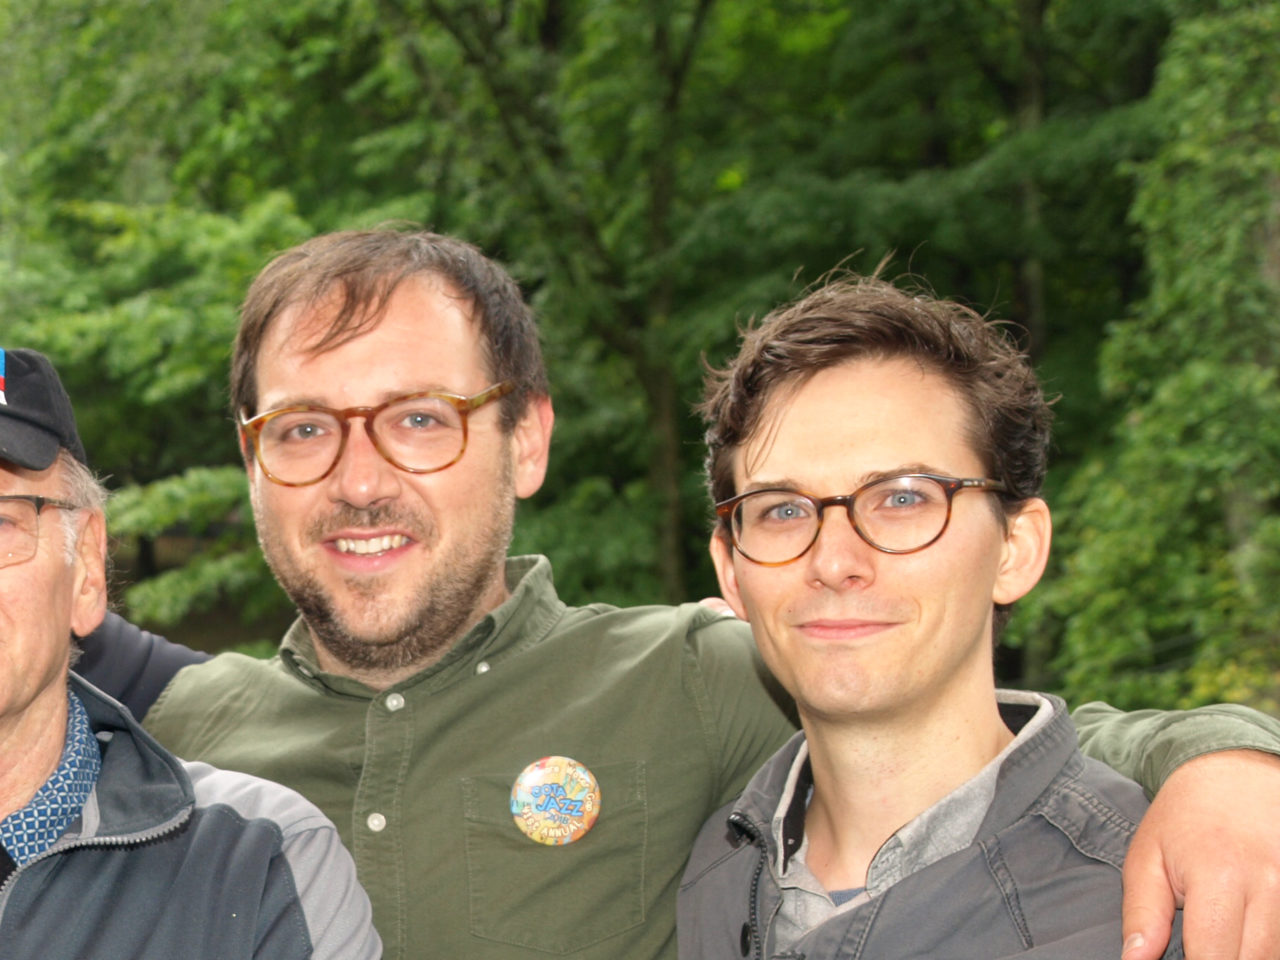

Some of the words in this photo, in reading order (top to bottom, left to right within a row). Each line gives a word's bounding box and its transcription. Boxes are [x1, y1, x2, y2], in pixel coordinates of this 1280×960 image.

[536, 795, 584, 817] JAZZ
[546, 812, 570, 825] 2018
[541, 819, 582, 838] ANNUAL
